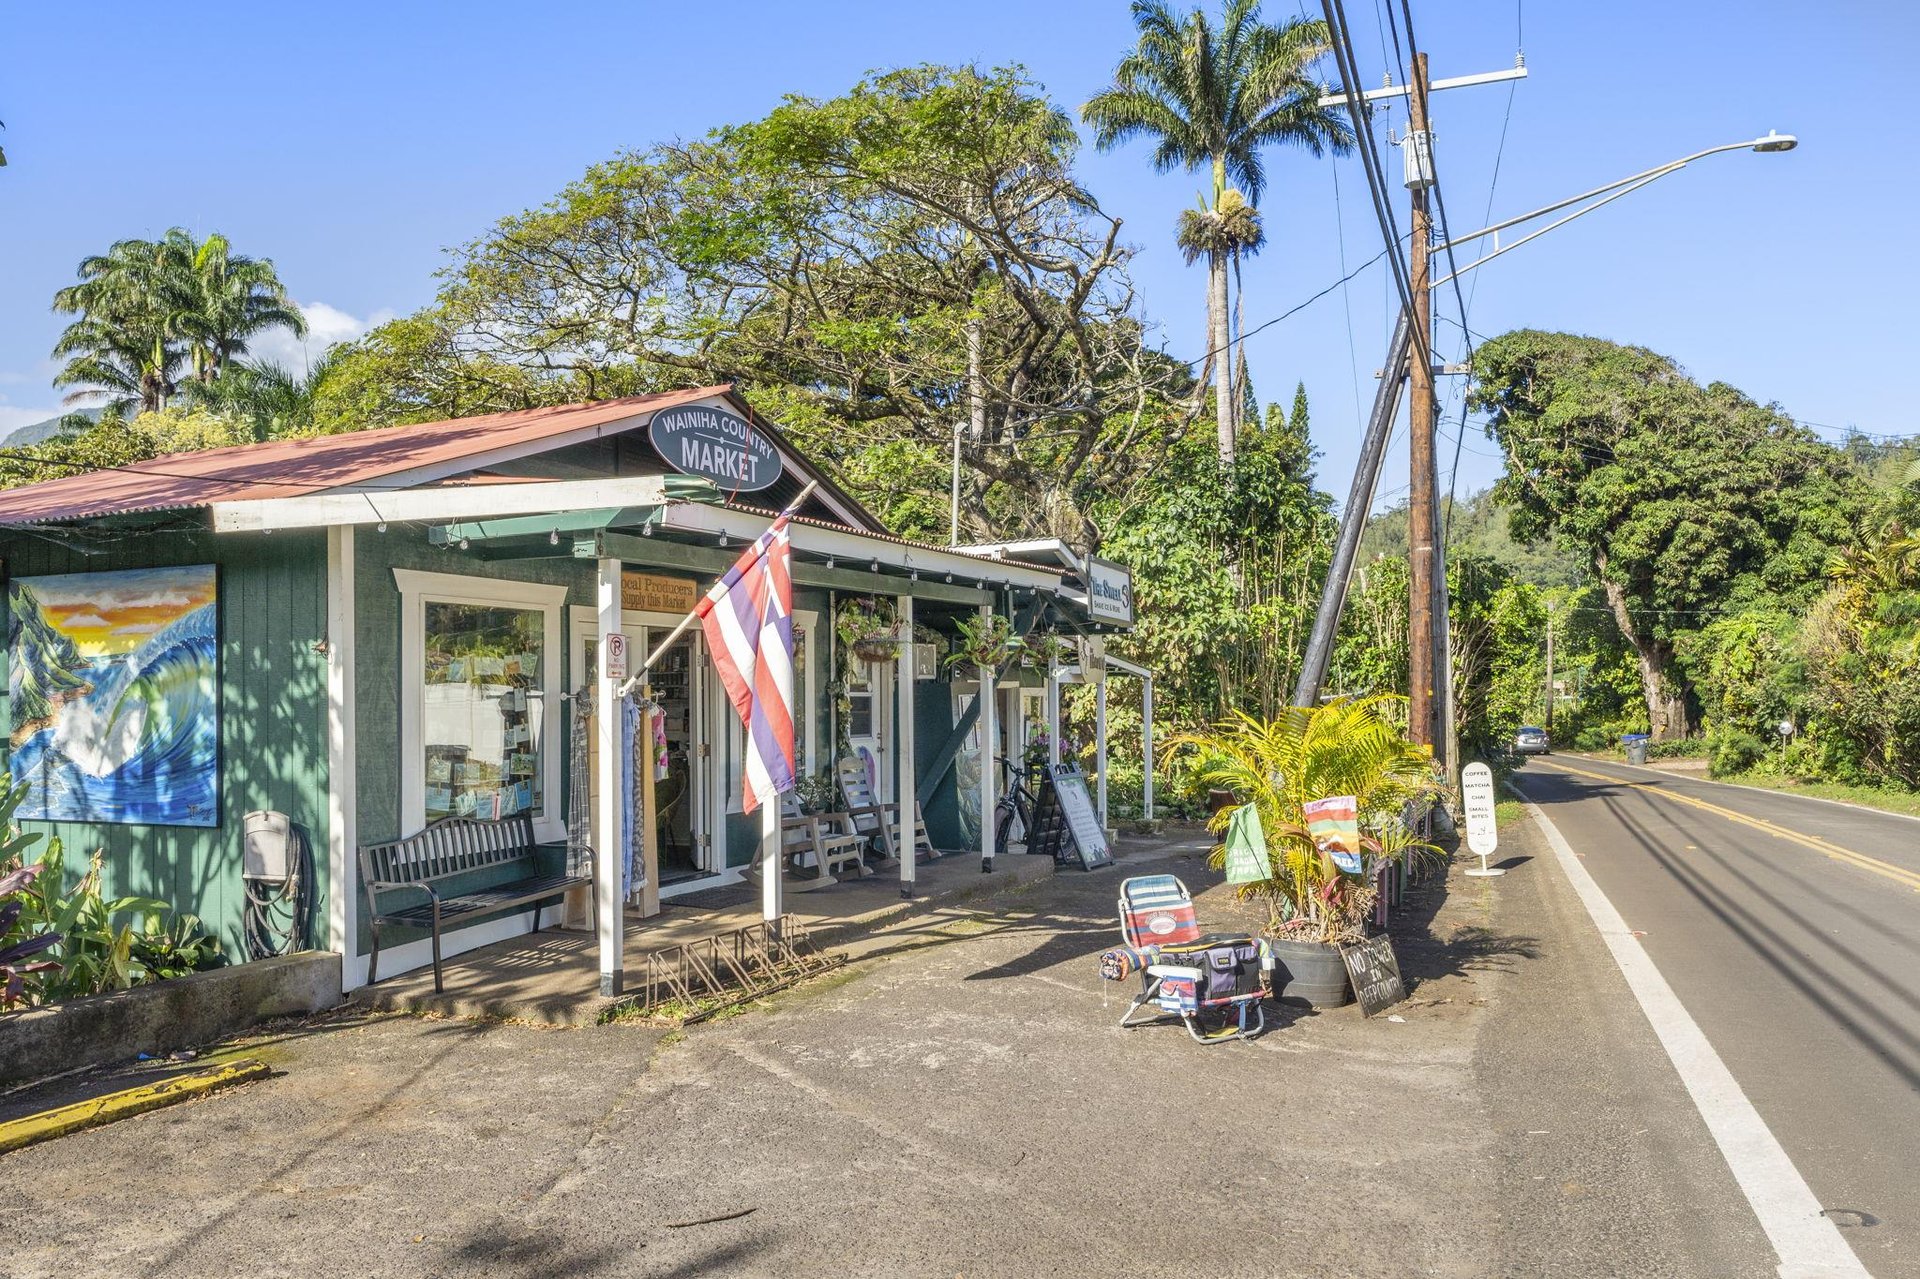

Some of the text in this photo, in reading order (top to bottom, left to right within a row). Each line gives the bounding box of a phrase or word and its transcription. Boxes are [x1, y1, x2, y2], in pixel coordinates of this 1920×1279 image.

[662, 411, 773, 459] WAINIHA COUNTRY
[681, 436, 758, 483] MARKET
[621, 576, 693, 596] ocal Producers
[621, 591, 646, 609] Supply
[647, 593, 661, 606] this
[1348, 952, 1366, 976] NO
[1370, 967, 1383, 982] IN
[1359, 984, 1378, 1007] DEEP
